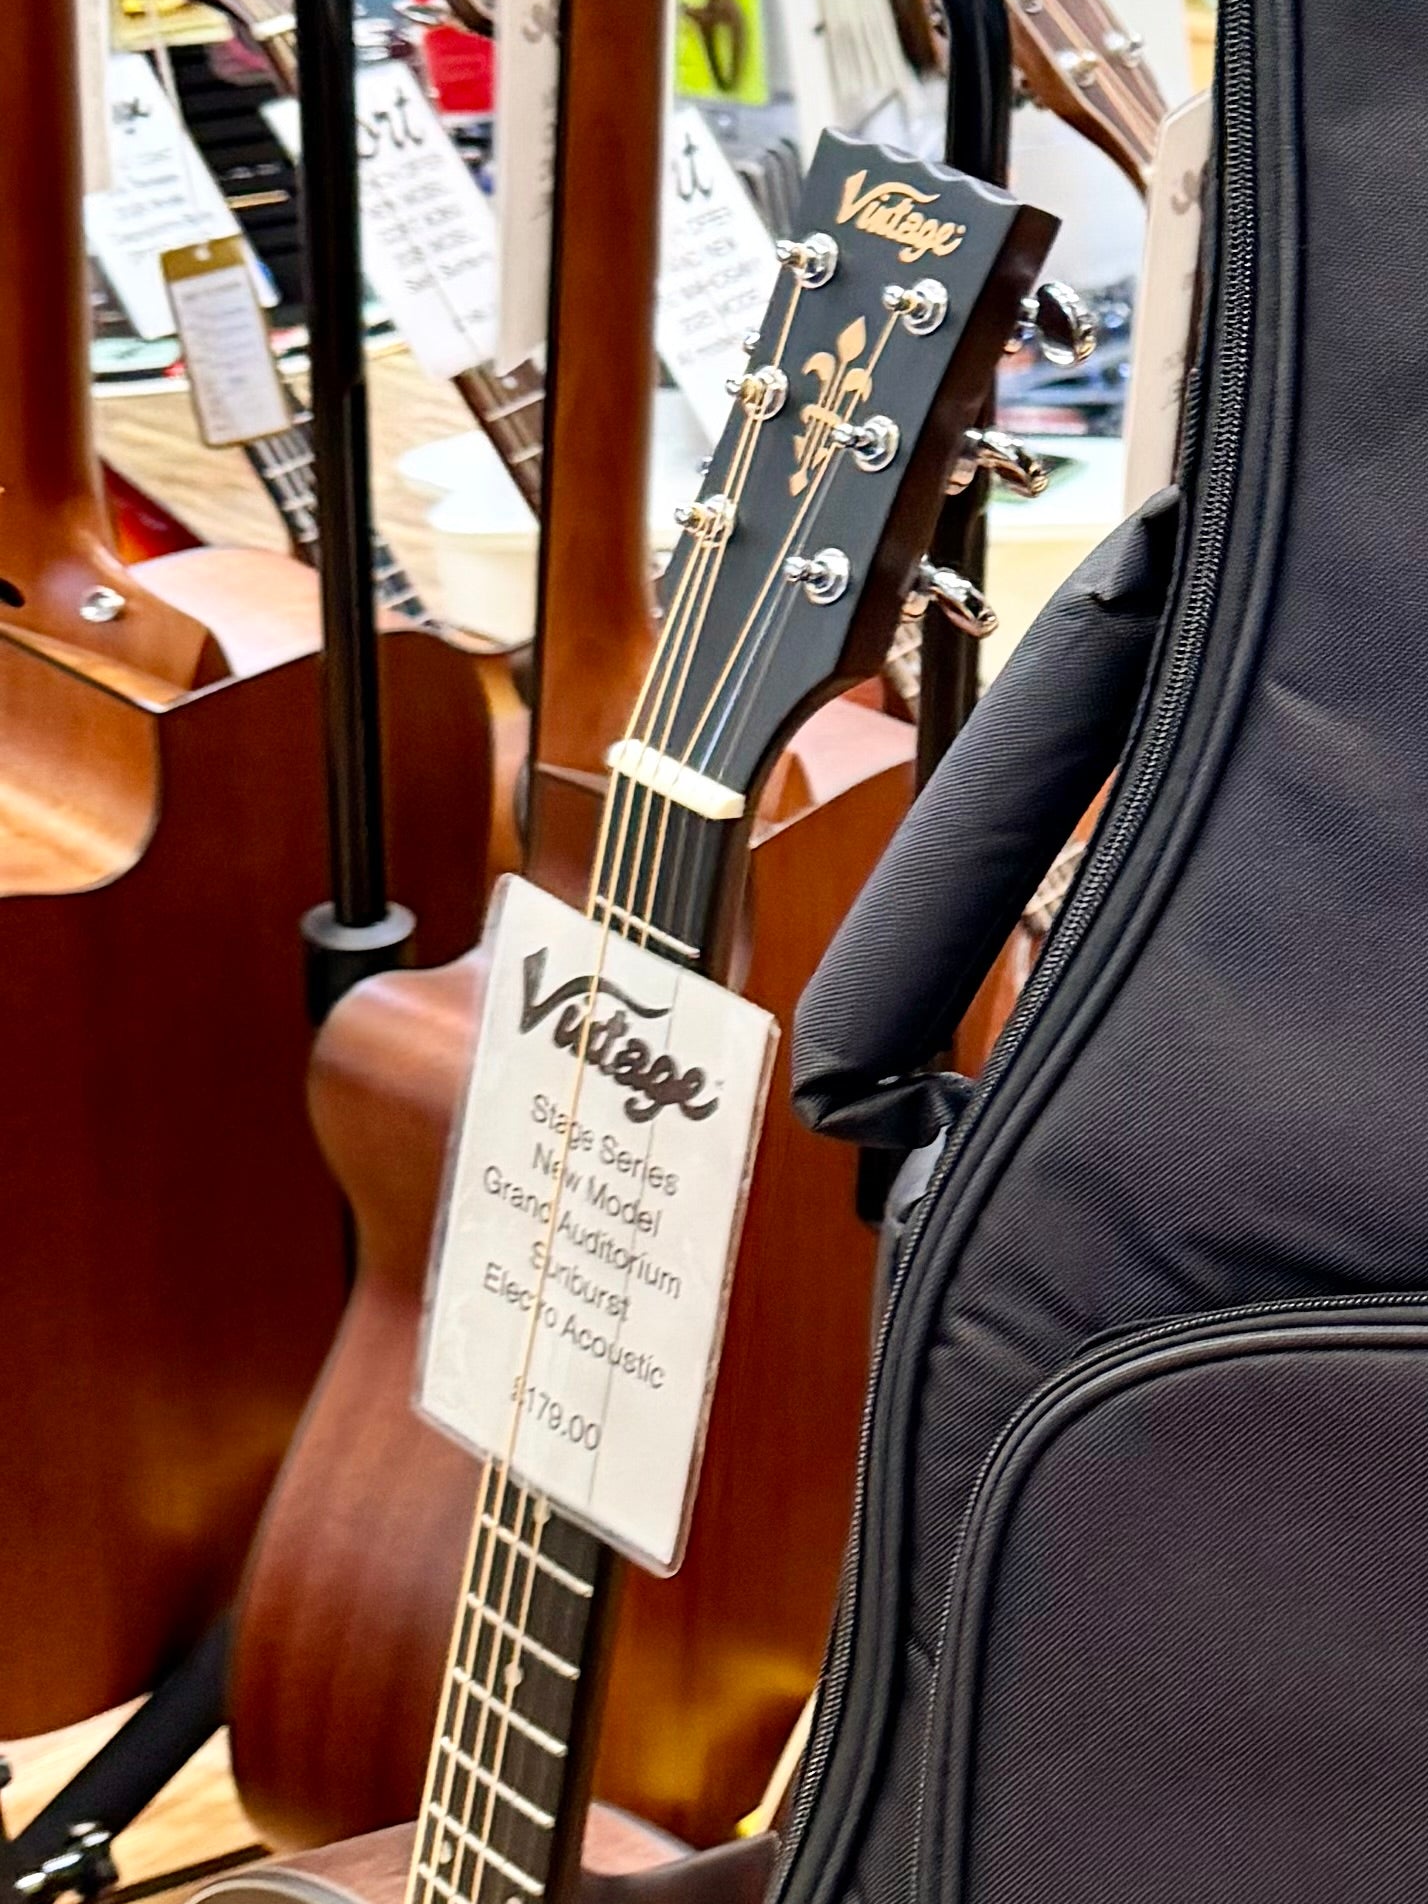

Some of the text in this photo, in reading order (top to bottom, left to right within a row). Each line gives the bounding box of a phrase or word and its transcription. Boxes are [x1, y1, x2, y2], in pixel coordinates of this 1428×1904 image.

[836, 169, 966, 263] Vintage
[519, 946, 719, 1124] Vintage
[531, 1094, 680, 1196] Stage Series
[557, 1210, 682, 1299] Auditorium
[586, 1174, 662, 1238] Model
[484, 1262, 667, 1390] Elecro Acoustic
